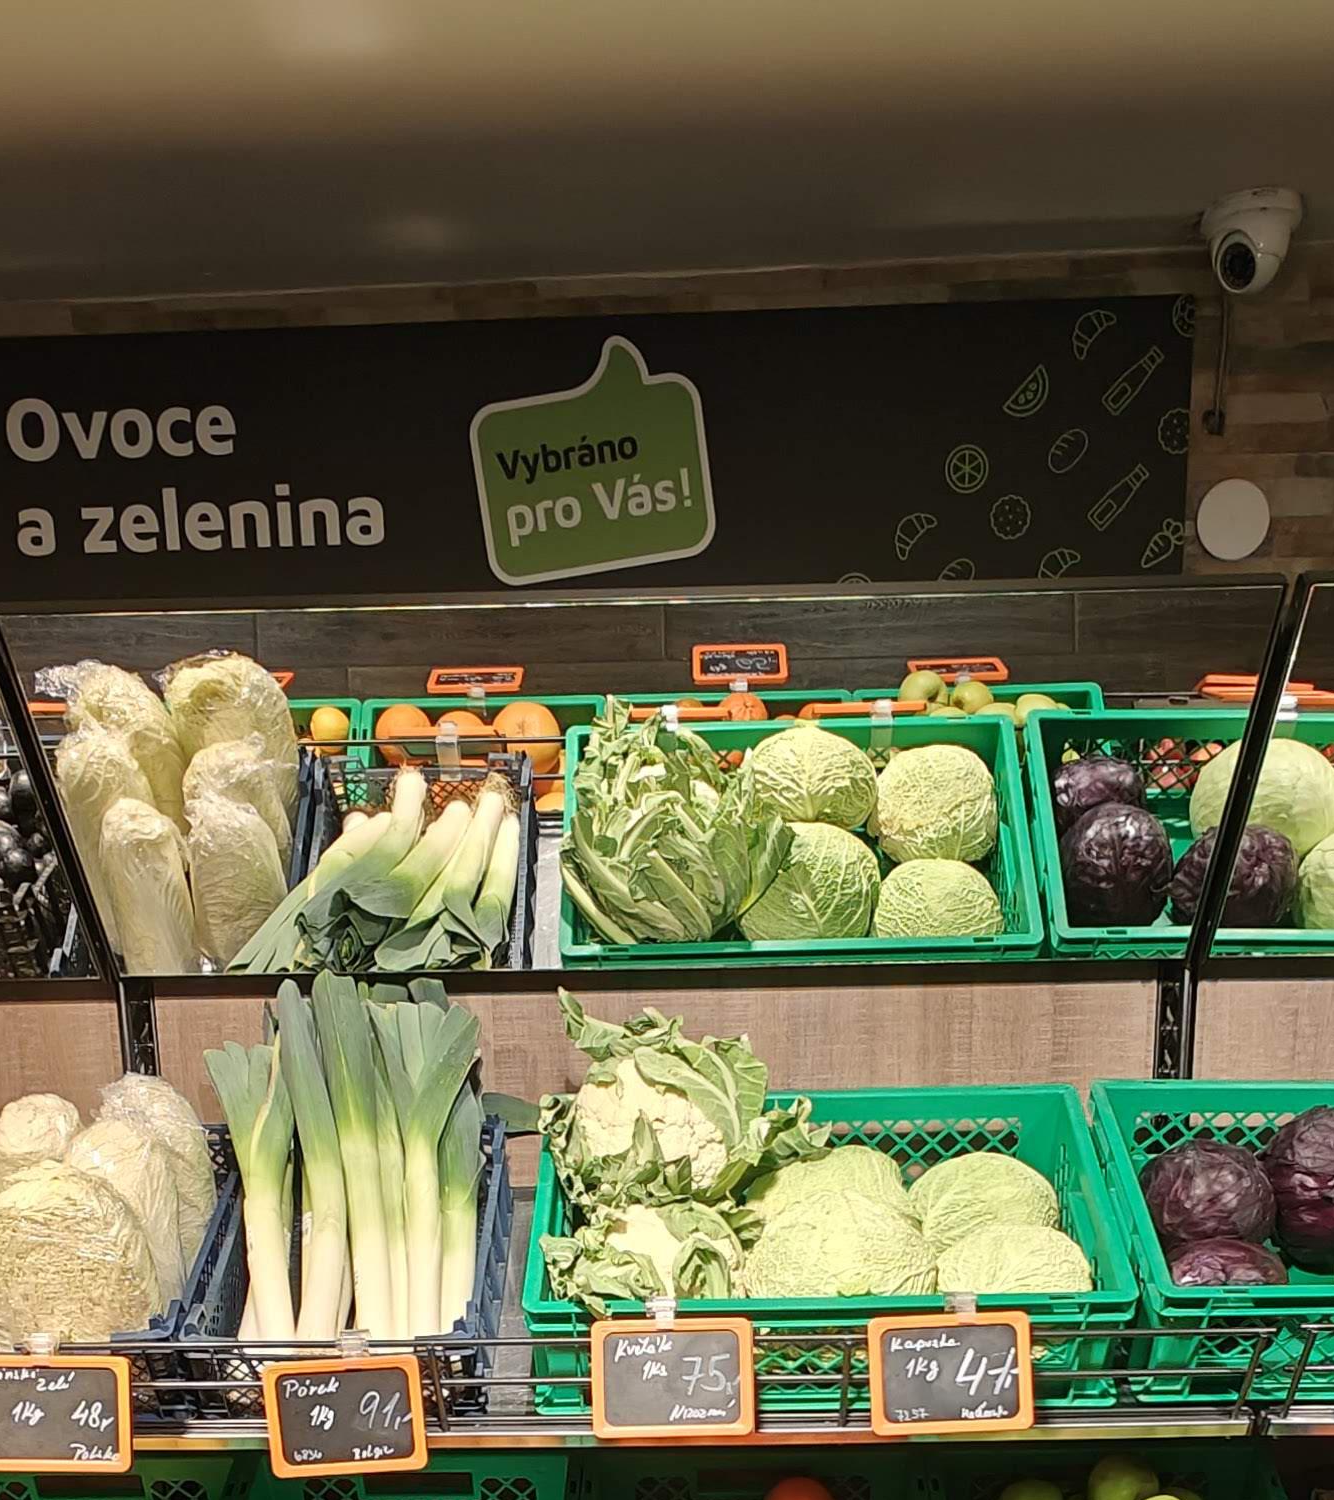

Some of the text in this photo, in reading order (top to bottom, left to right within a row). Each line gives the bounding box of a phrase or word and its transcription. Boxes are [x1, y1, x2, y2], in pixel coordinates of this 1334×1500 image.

[6, 398, 236, 462] Ovoce
[495, 436, 638, 484] Vybráno
[17, 484, 385, 557] a zelenina
[507, 467, 692, 547] pro Vás!
